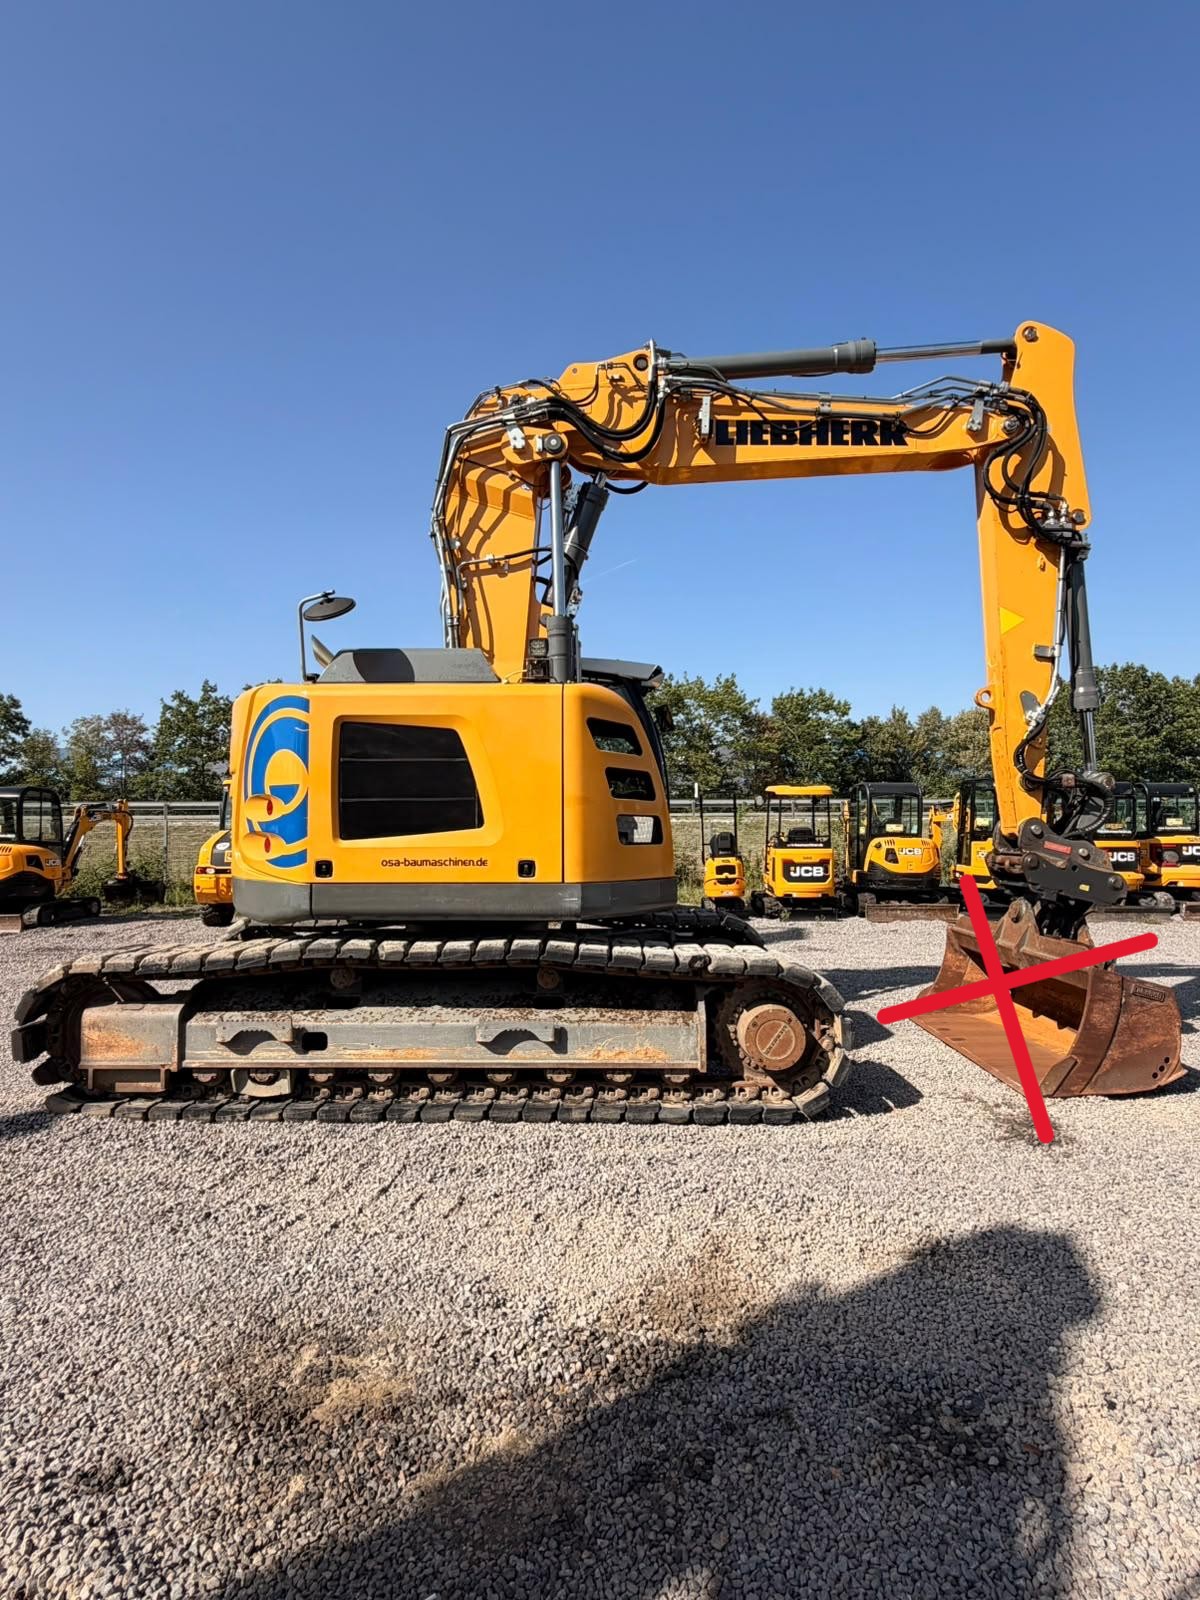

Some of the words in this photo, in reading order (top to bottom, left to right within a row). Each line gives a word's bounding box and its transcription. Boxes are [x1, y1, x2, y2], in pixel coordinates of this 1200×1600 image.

[716, 419, 908, 445] LIEBHERR
[898, 847, 922, 855] JCB
[1182, 845, 1200, 856] JC
[380, 857, 488, 867] osa-baumaschinen.de
[1109, 852, 1136, 862] JCB
[790, 866, 824, 877] JCB
